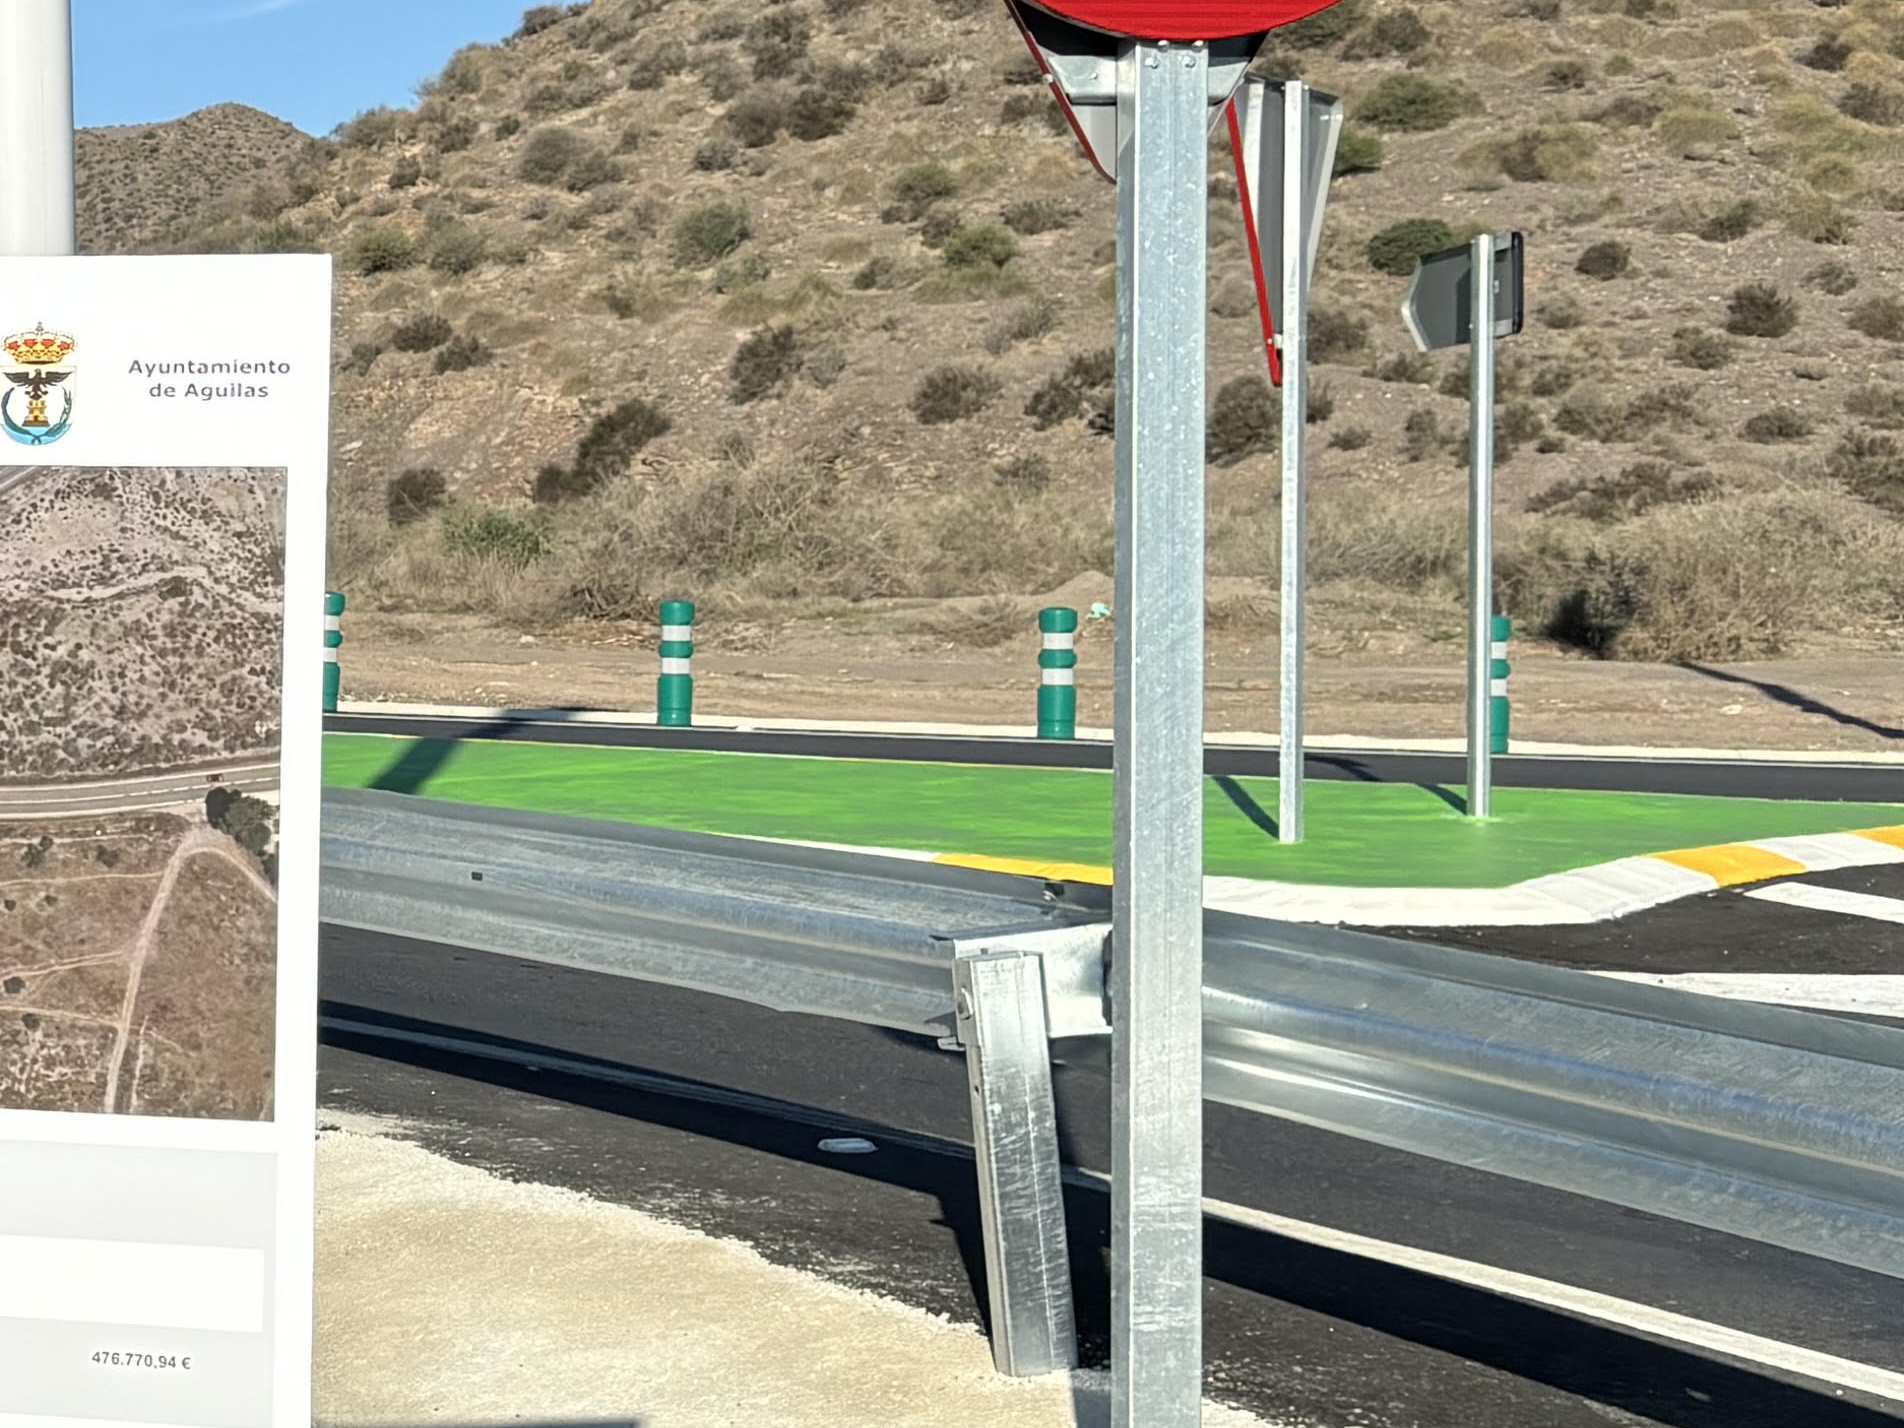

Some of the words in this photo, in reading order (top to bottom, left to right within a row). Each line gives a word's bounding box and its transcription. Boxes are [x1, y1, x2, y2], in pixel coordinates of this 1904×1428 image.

[128, 359, 291, 379] Ayuntamiento
[149, 383, 176, 398] de
[185, 383, 269, 401] Aguilas
[91, 1351, 177, 1369] 476.770,94
[181, 1356, 191, 1370] €
